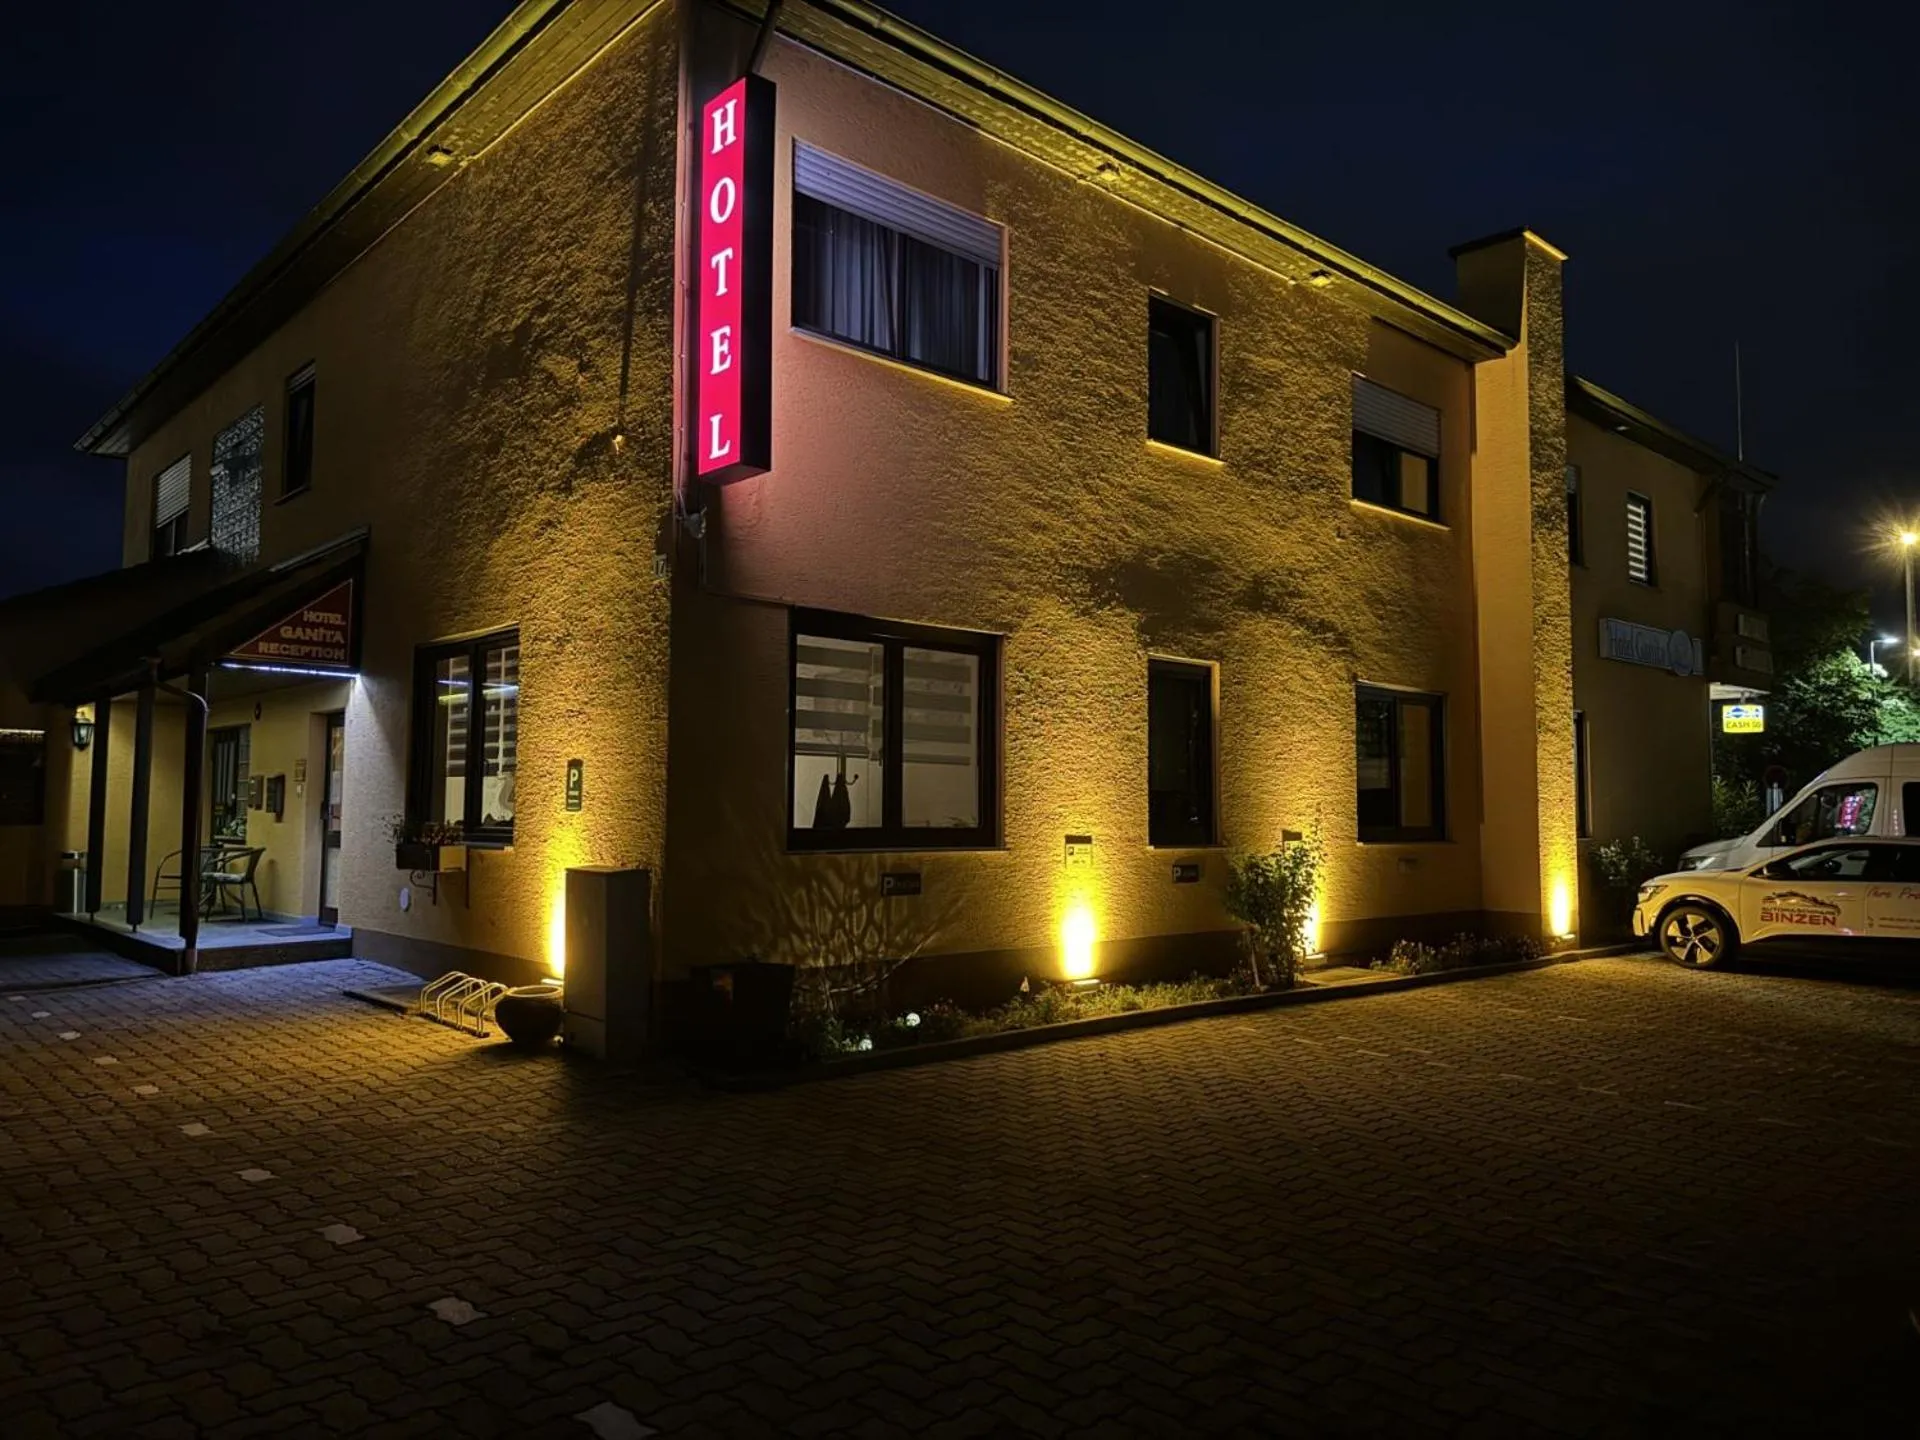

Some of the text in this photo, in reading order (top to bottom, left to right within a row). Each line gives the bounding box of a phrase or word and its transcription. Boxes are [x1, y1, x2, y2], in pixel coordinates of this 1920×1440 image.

[709, 98, 737, 460] HOTEL
[303, 610, 346, 624] HOTEL
[259, 641, 344, 660] RECEPTION
[569, 769, 579, 788] P
[1173, 867, 1182, 881] P
[883, 876, 894, 896] P
[1760, 912, 1836, 926] BINZEN
